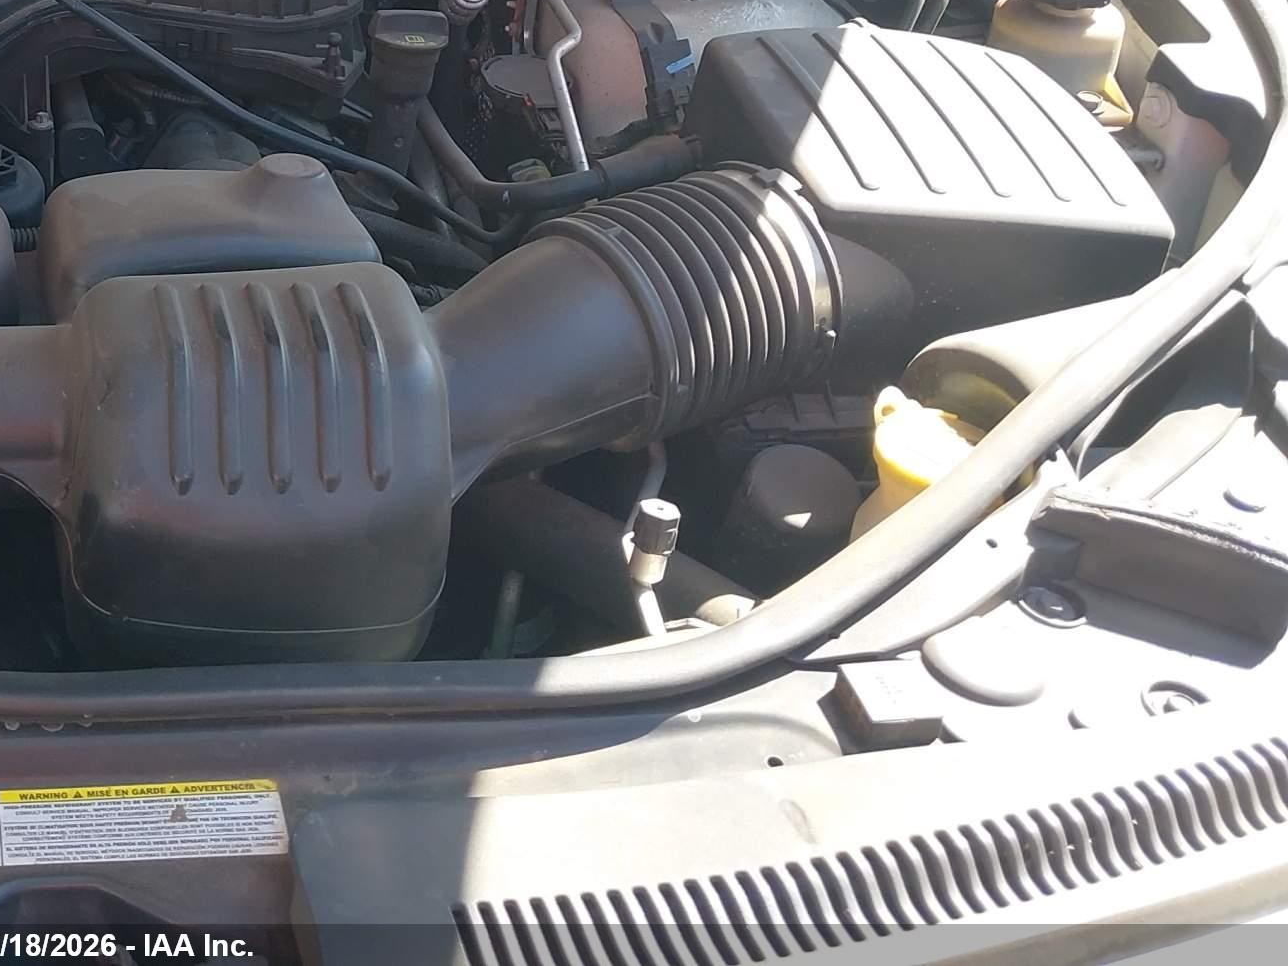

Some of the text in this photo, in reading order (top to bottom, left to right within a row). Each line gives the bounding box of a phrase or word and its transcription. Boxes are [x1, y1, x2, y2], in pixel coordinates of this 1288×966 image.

[19, 791, 68, 800] WARNING
[114, 788, 129, 796] EN
[131, 787, 167, 795] GARDE
[183, 783, 256, 793] ADVERTENCIA
